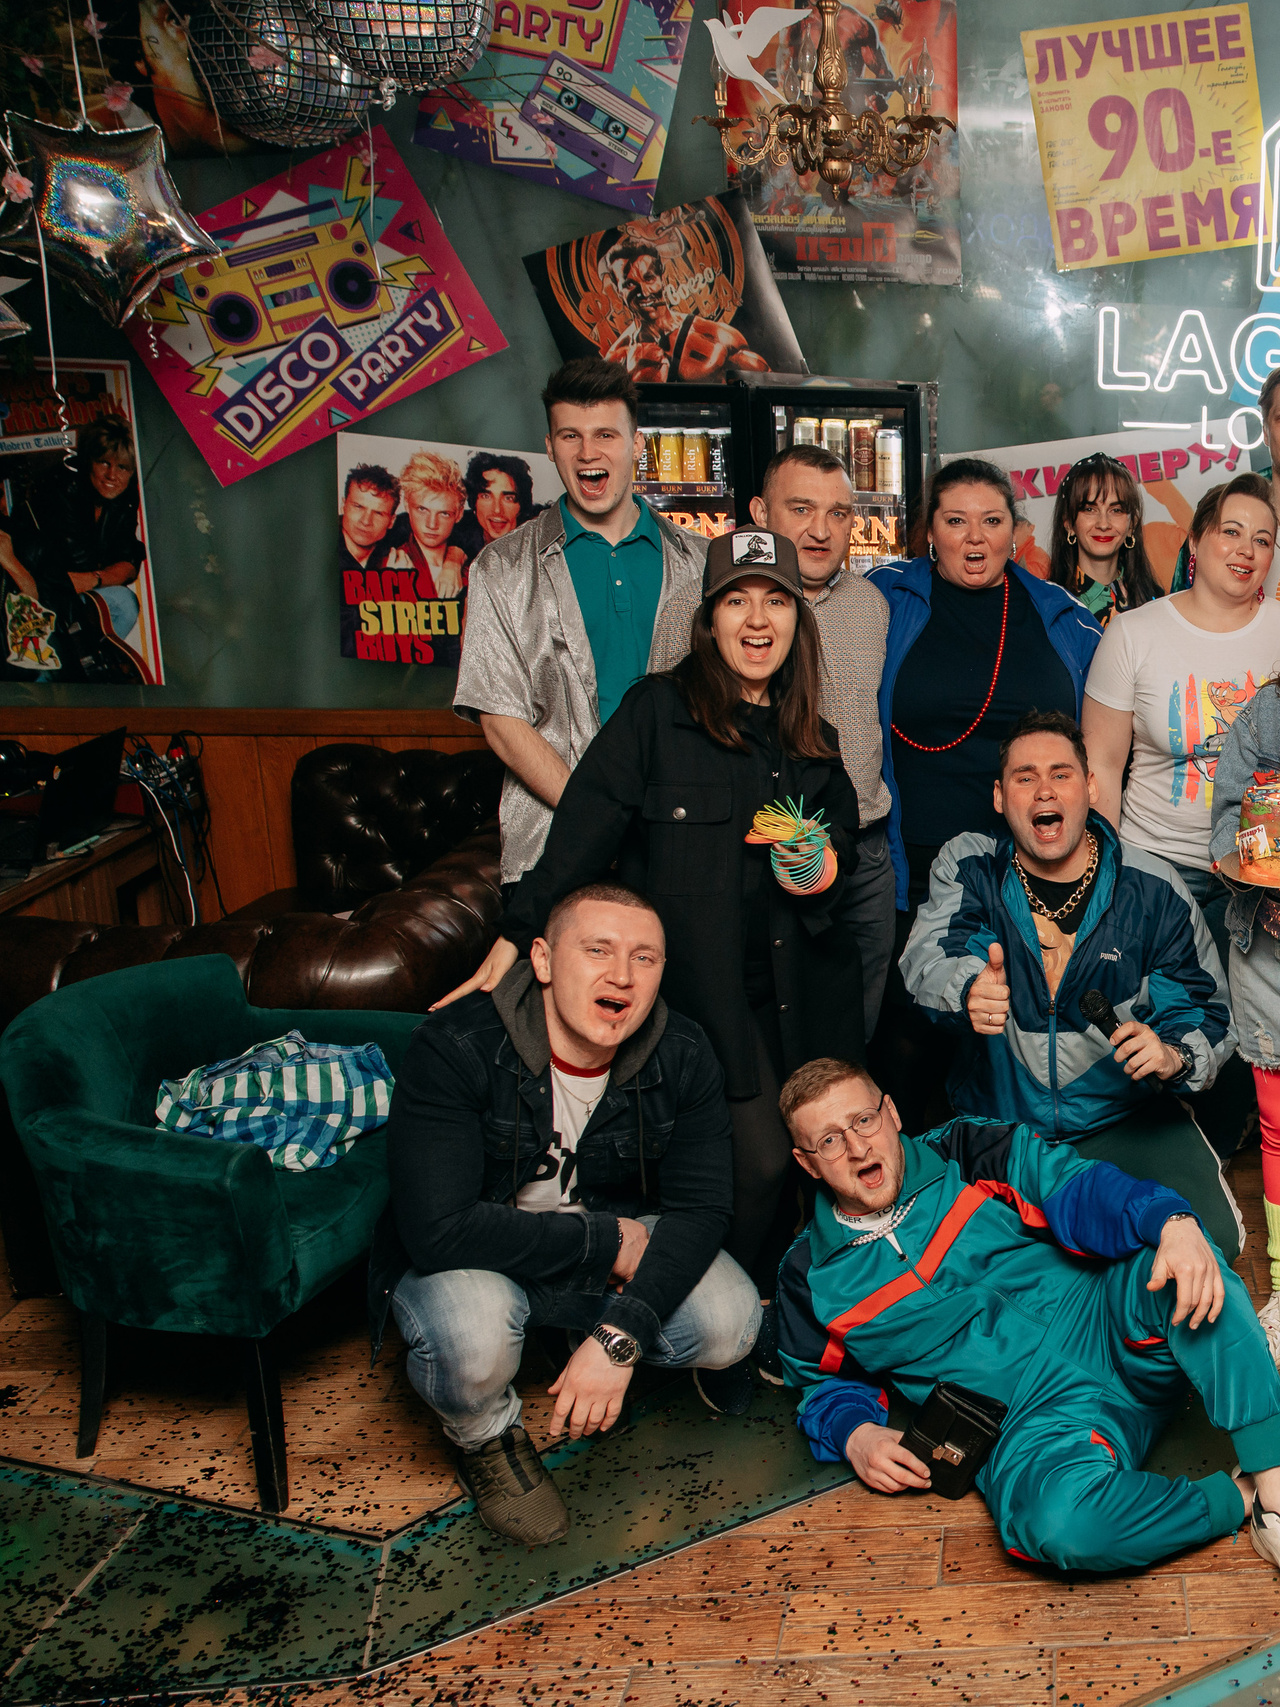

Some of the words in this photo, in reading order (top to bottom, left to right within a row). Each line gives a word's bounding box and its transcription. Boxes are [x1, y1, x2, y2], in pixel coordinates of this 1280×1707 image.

[493, 1, 604, 52] ARTY
[1034, 14, 1246, 84] ЛУЧШЕЕ
[555, 66, 573, 82] 90
[607, 140, 629, 157] STEREO
[1088, 87, 1235, 182] 90-Е
[1056, 182, 1268, 263] ВРЕМЯ
[339, 299, 445, 400] PARTY
[222, 331, 340, 443] DISCO
[662, 449, 672, 471] Rich
[687, 448, 696, 471] Rich
[712, 448, 722, 471] Rich
[1010, 463, 1072, 500] КИ
[1119, 434, 1243, 483] ЕРХ!
[661, 485, 683, 493] BURN
[696, 485, 718, 493] BURN
[850, 516, 898, 545] RN
[850, 546, 880, 555] DRINK
[343, 570, 418, 606] BACK
[358, 600, 460, 636] STREET
[355, 630, 434, 665] BOYS
[1100, 952, 1118, 962] PUMA
